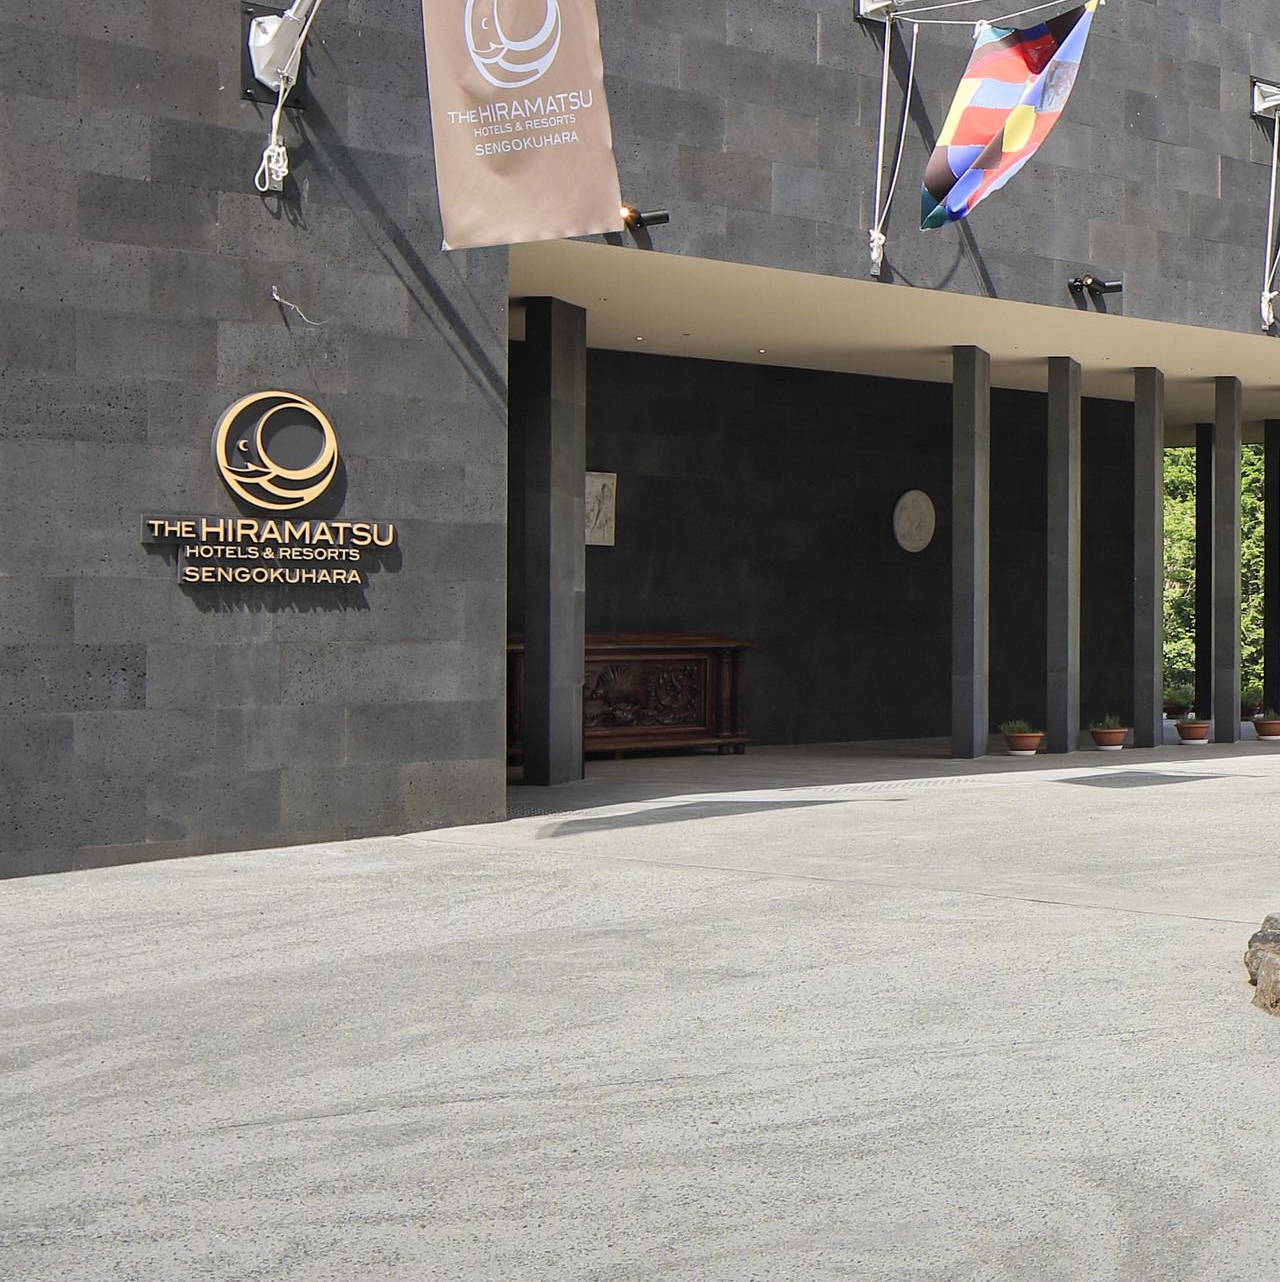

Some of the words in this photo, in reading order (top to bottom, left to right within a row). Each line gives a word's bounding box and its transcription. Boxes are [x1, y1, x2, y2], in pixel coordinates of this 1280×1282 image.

[447, 109, 478, 124] THE
[478, 89, 593, 124] HIRAMATSU
[474, 123, 513, 137] HOTELS
[515, 122, 523, 131] &
[525, 114, 576, 130] RESORTS
[475, 131, 579, 156] SENGOKUHARA
[148, 520, 196, 538] THE
[201, 518, 394, 547] HIRAMATSU
[186, 545, 260, 560] HOTELS
[263, 547, 275, 559] &
[279, 548, 361, 562] RESORTS
[184, 567, 363, 585] SENGOKUHARA
